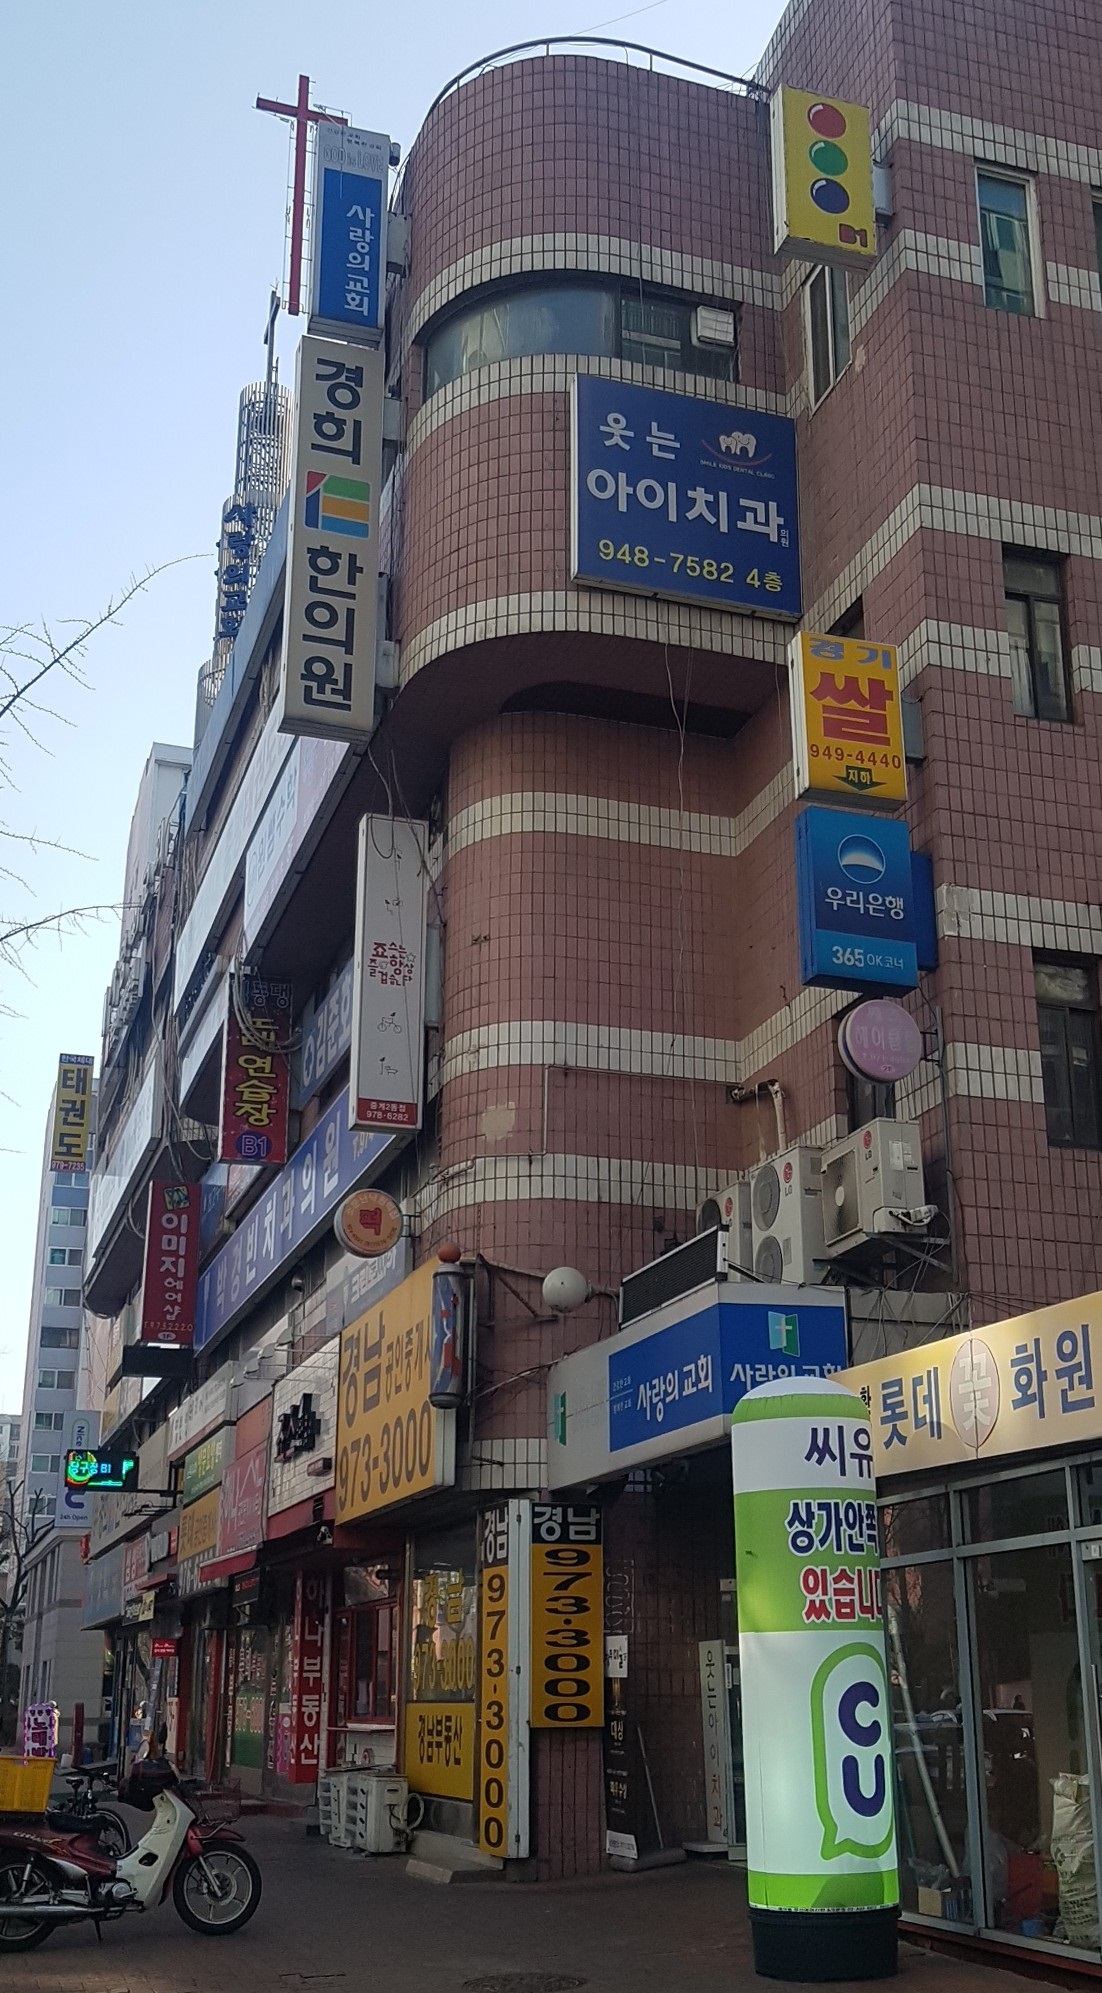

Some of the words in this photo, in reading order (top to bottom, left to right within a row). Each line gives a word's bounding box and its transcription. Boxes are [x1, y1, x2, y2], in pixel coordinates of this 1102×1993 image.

[324, 145, 346, 164] GOD
[358, 150, 384, 173] LOVE
[310, 357, 363, 466] 경희
[732, 465, 754, 476] DENTAL
[586, 468, 784, 543] 아이치과
[599, 539, 734, 584] 948-7582
[745, 568, 782, 593] 4층
[300, 545, 364, 712] 한의원
[809, 637, 892, 671] 경기
[809, 671, 894, 747] 쌀
[809, 743, 901, 769] 949-4440
[847, 769, 872, 785] 지하
[824, 886, 904, 921] 우리은행
[390, 954, 414, 975] 항상
[831, 945, 864, 967] 365
[55, 1068, 88, 1158] 태권도
[241, 1133, 268, 1157] B1
[159, 1212, 189, 1278] 이미지
[342, 1310, 386, 1429] 경남
[636, 1369, 679, 1422] 사랑의
[682, 1354, 713, 1397] 교회
[880, 1366, 943, 1450] 롯데
[958, 1352, 992, 1431] 꽃
[1010, 1324, 1096, 1420] 화원
[338, 1400, 432, 1512] 973-3000
[804, 1425, 873, 1479] 씨유
[485, 1510, 509, 1564] 경남
[533, 1505, 600, 1542] 경남
[786, 1501, 877, 1555] 상가안쪽
[300, 1577, 323, 1766] 하나부동산
[418, 1714, 463, 1768] 경남부동산
[838, 1681, 886, 1818] CU
